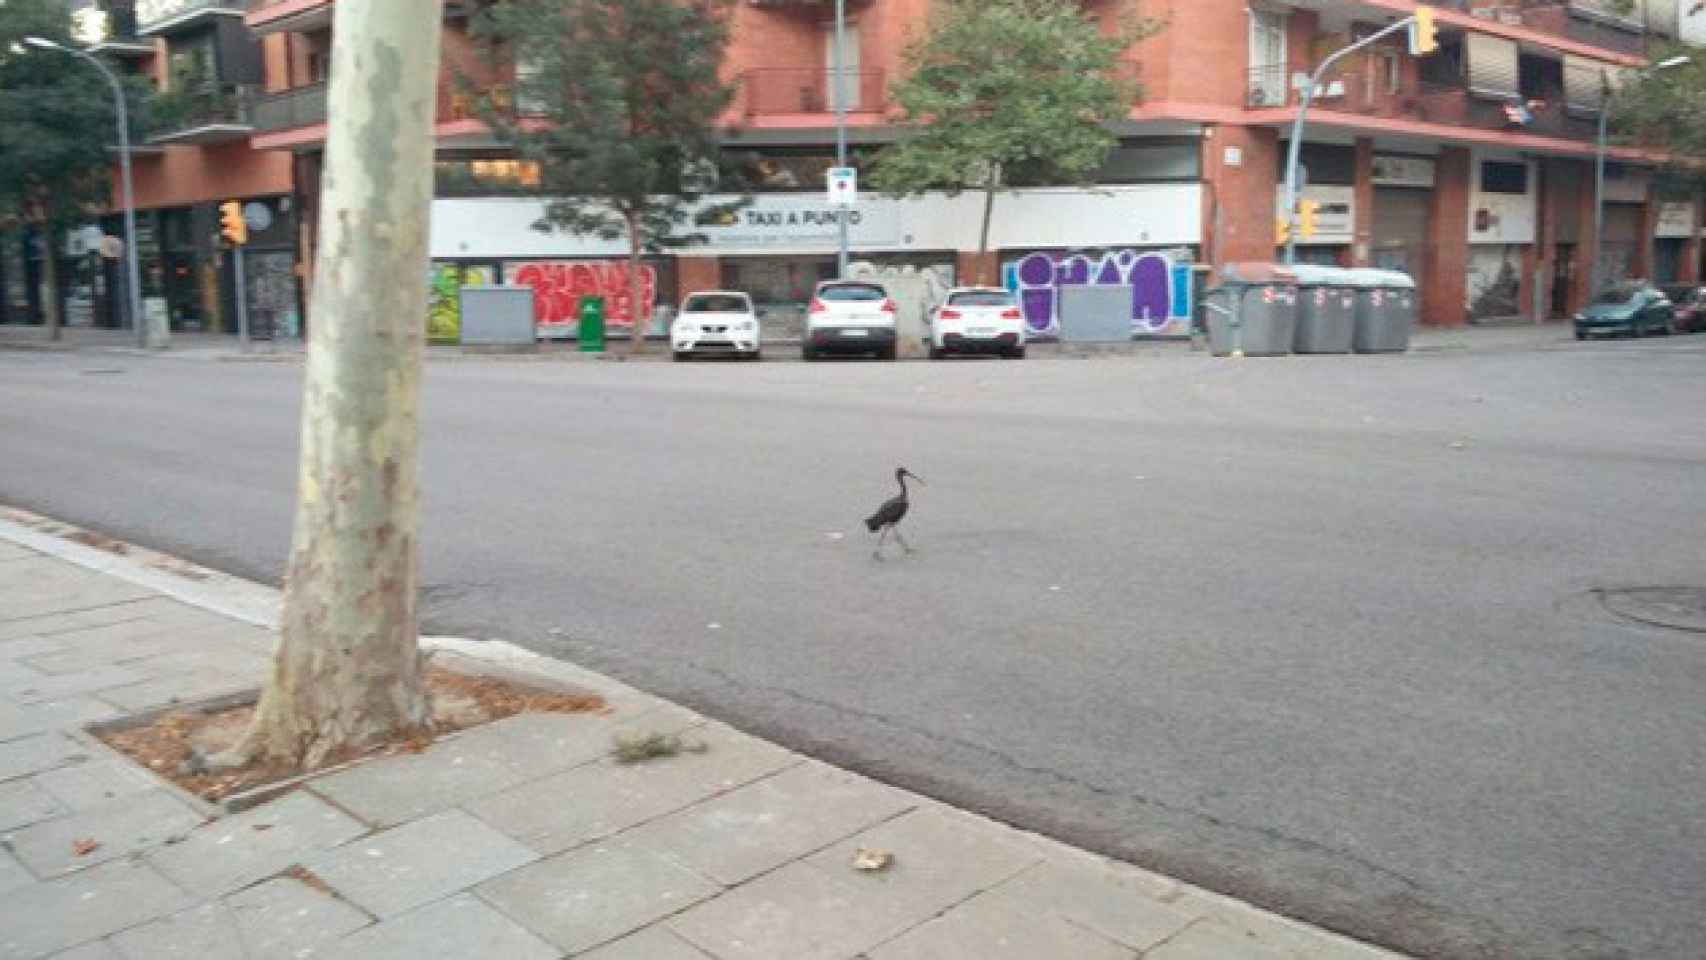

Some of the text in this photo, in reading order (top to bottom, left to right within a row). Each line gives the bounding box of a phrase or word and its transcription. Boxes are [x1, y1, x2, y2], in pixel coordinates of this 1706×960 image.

[747, 211, 862, 225] TAXI A PUNO
